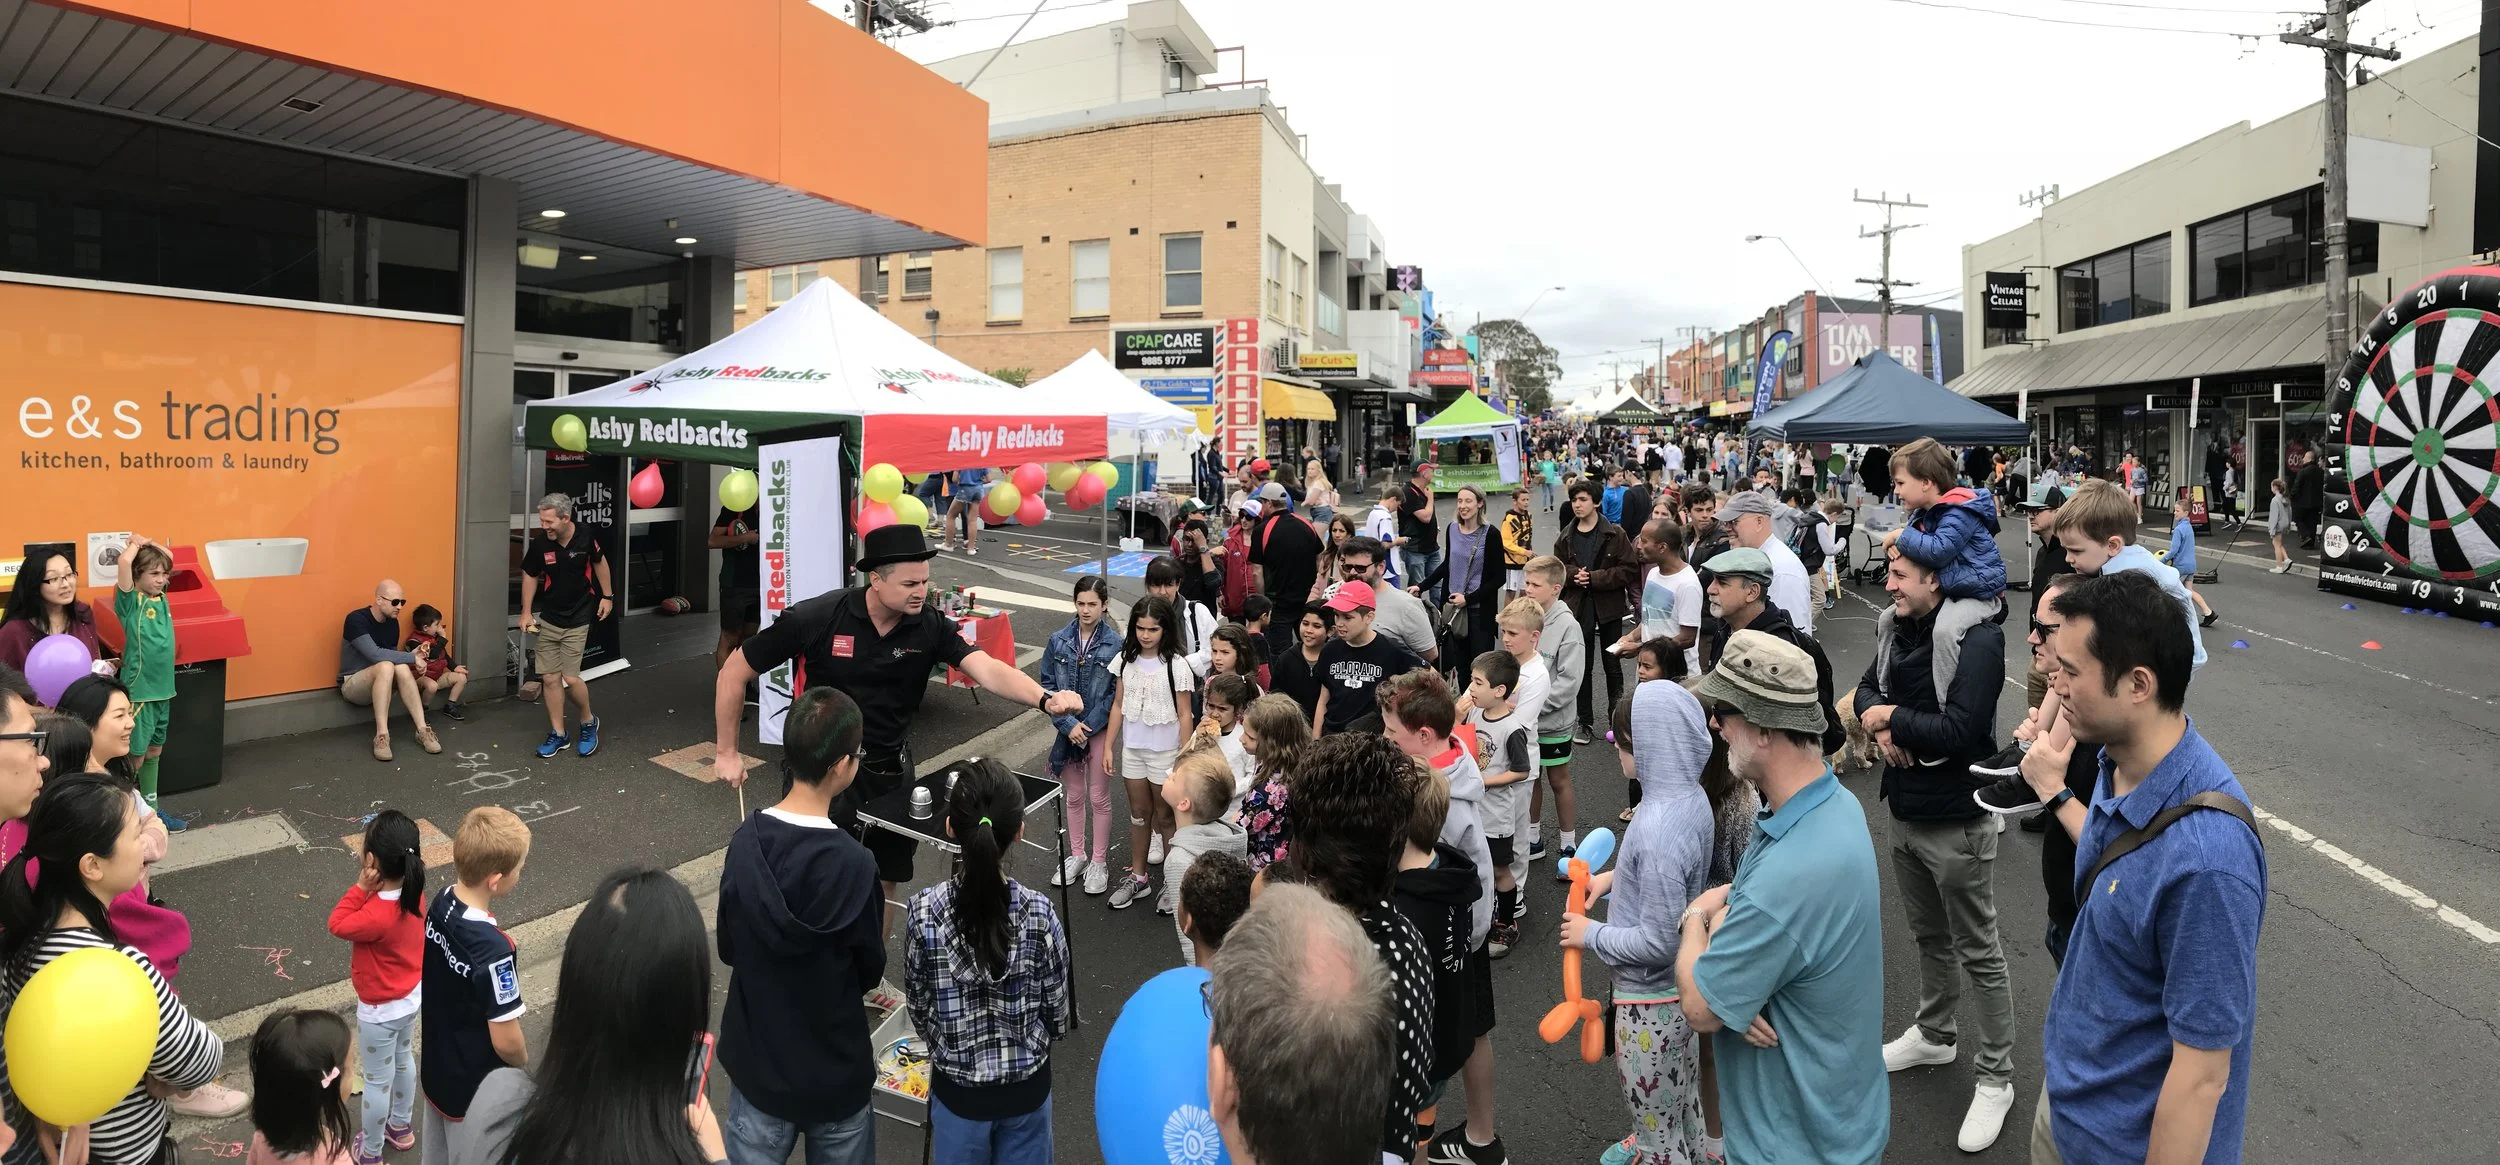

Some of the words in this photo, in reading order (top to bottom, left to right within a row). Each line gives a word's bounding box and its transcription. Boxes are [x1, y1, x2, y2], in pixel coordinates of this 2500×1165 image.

[2417, 284, 2437, 309] 20
[2459, 280, 2469, 300] 1
[2387, 307, 2398, 326] 5
[1126, 333, 1203, 349] CPAPCARE
[1824, 324, 1873, 345] TIM
[2358, 334, 2377, 357] 12
[1165, 355, 1186, 365] 9777
[1299, 356, 1318, 365] Star
[1321, 355, 1343, 365] Cuts
[1829, 345, 1918, 366] DWER
[2338, 377, 2351, 392] 9
[19, 397, 54, 438] e
[66, 394, 103, 439] &
[113, 400, 142, 440] s
[161, 390, 341, 455] trading
[590, 416, 634, 448] Ashy
[639, 418, 748, 449] Redbacks
[2328, 412, 2342, 435] 14
[948, 424, 993, 457] Ashy
[996, 423, 1064, 449] Redbacks
[21, 451, 109, 471] kitchen,
[121, 452, 213, 469] bathroom
[222, 453, 235, 469] &
[244, 453, 309, 473] laundry
[2328, 455, 2342, 476] 11
[575, 502, 612, 528] raig
[2335, 499, 2349, 513] 8
[765, 459, 786, 612] Redbacks
[2352, 530, 2370, 552] 16
[2381, 561, 2395, 578] 7
[2321, 570, 2397, 592] www.dartballvictoria.com
[2411, 579, 2432, 599] 19
[2454, 586, 2464, 605] 3
[1330, 661, 1382, 678] COLORADO
